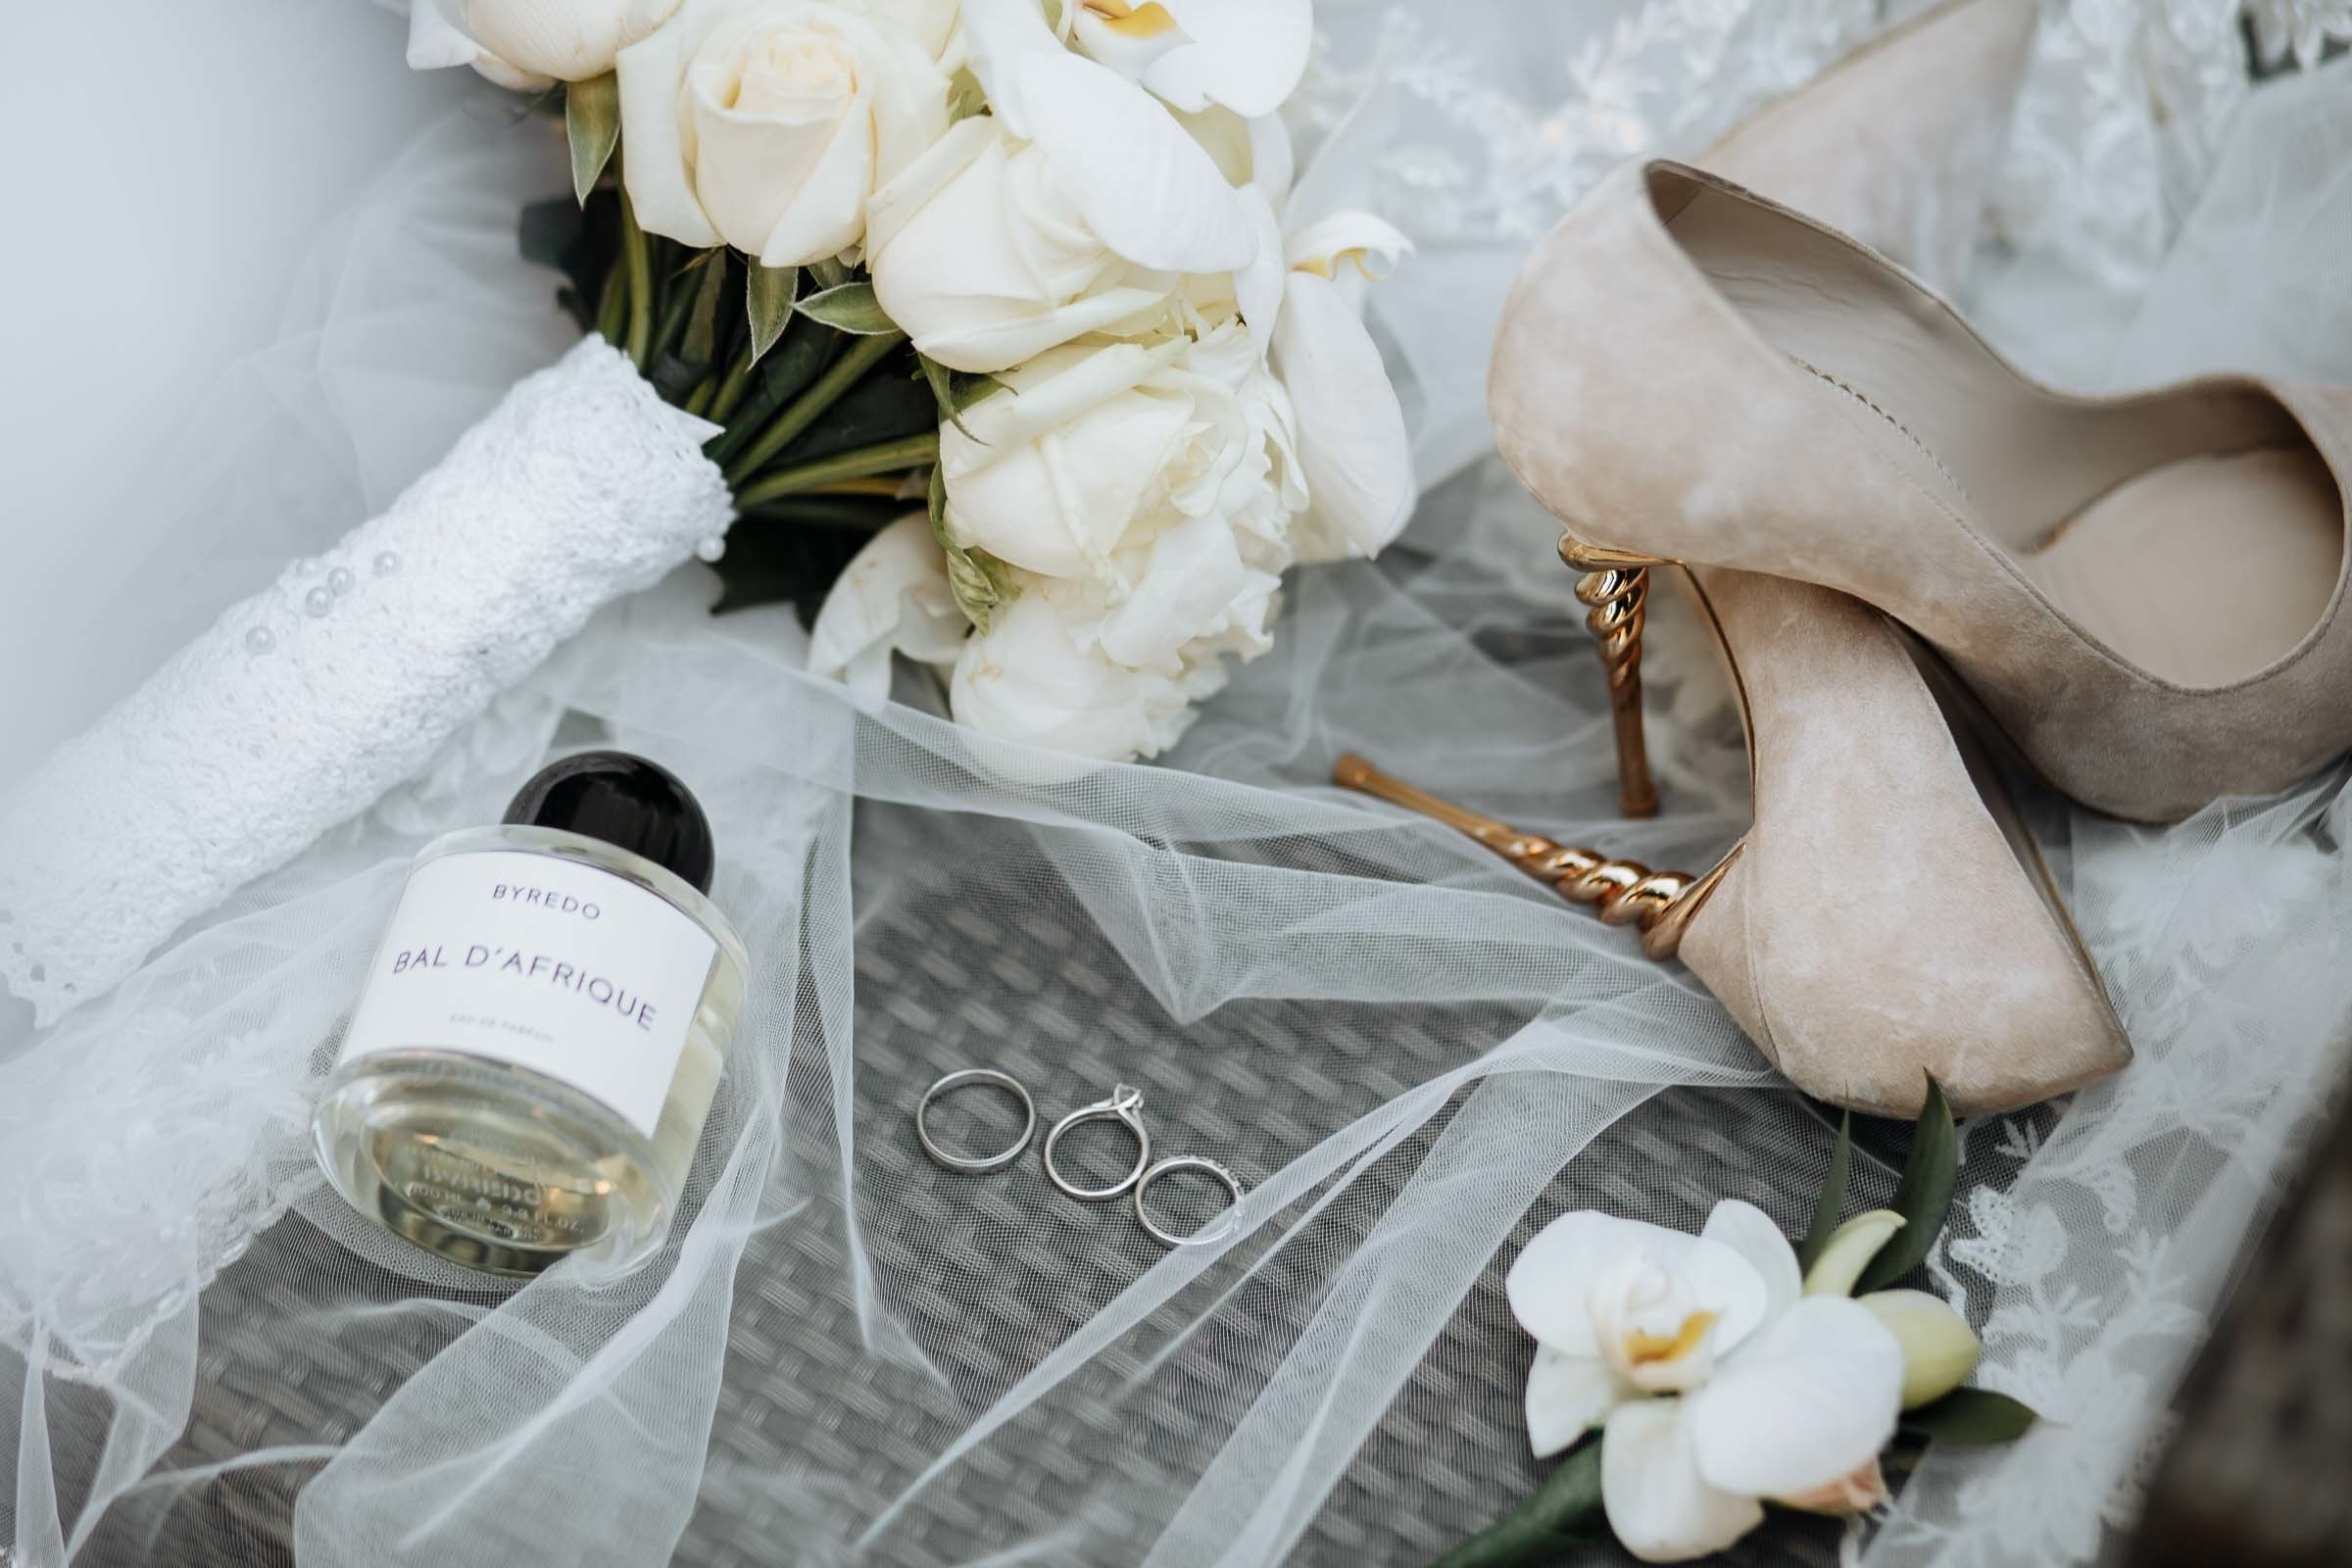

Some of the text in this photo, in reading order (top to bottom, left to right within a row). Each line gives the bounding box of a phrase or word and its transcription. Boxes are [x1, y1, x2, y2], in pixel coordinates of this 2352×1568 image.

[492, 884, 601, 920] BYREDO
[393, 944, 658, 1032] BAL D'AFRIQUE
